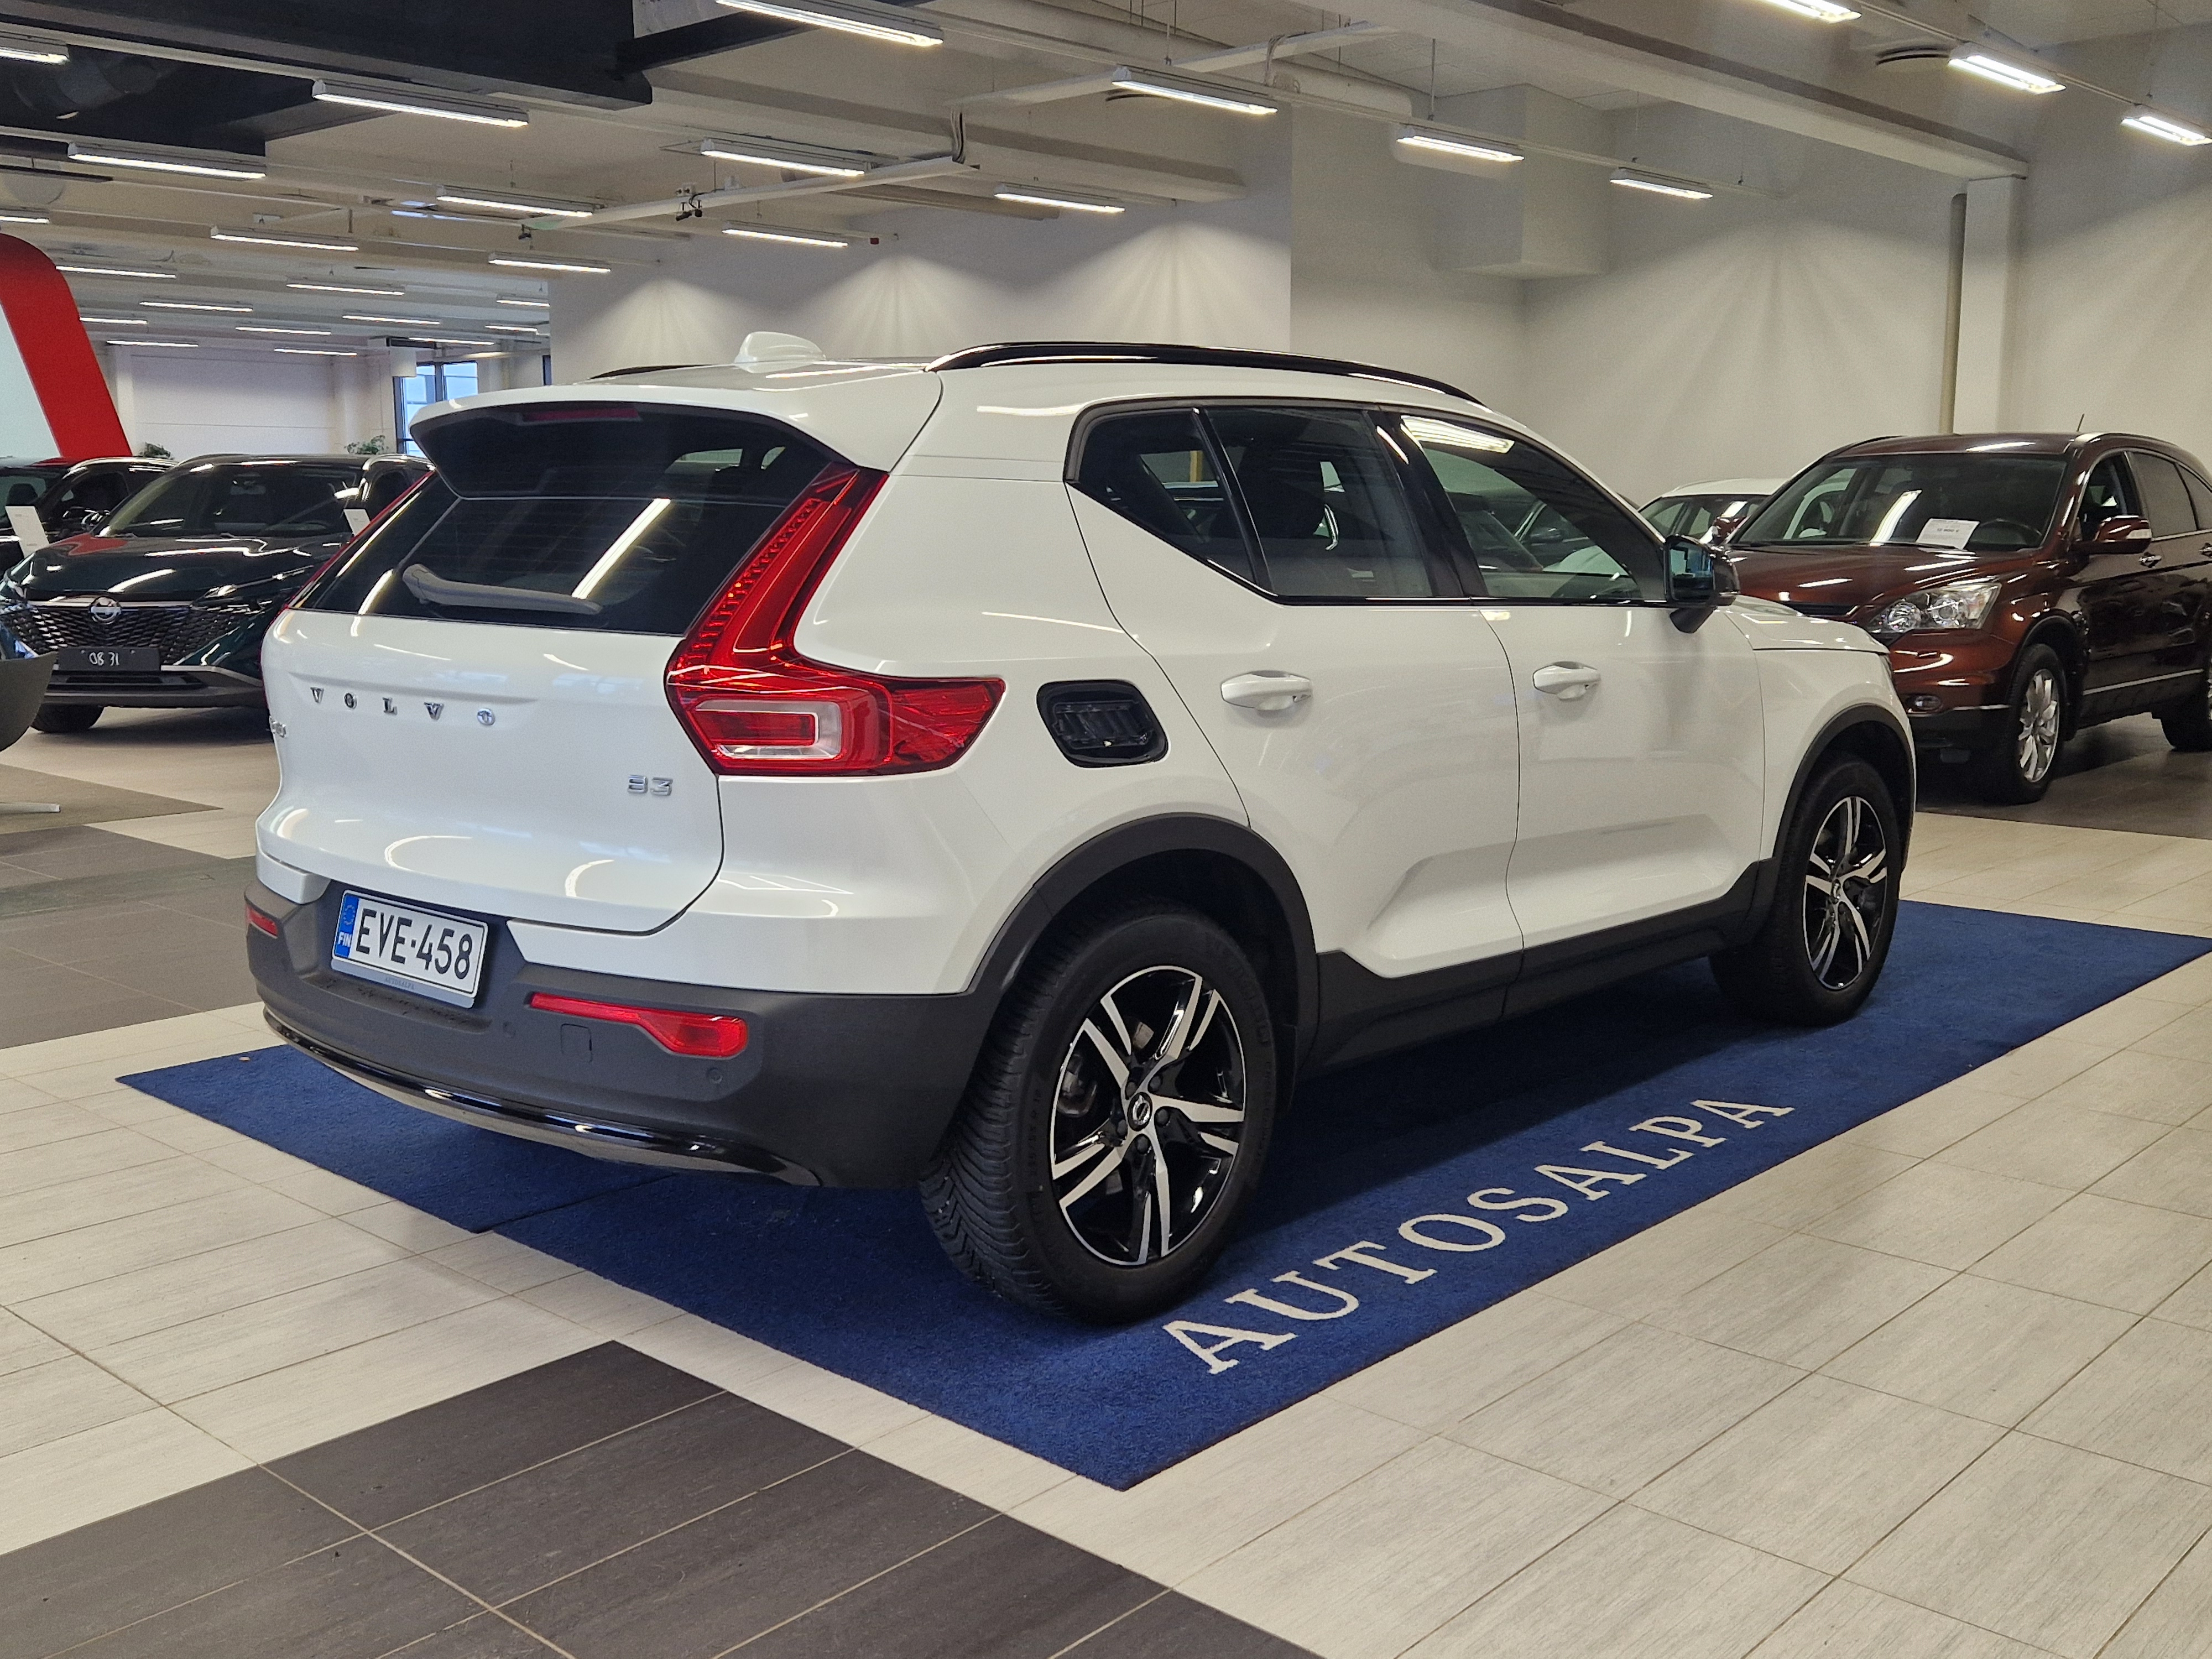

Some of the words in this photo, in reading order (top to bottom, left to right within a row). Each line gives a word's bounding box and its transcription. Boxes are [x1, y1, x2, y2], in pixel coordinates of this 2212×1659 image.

[89, 652, 104, 666] 08
[310, 687, 495, 726] VOLVO
[628, 775, 674, 796] B3
[337, 931, 352, 947] FIN
[356, 908, 473, 979] EVE-458
[1164, 1098, 1795, 1374] AUTOSALPA
